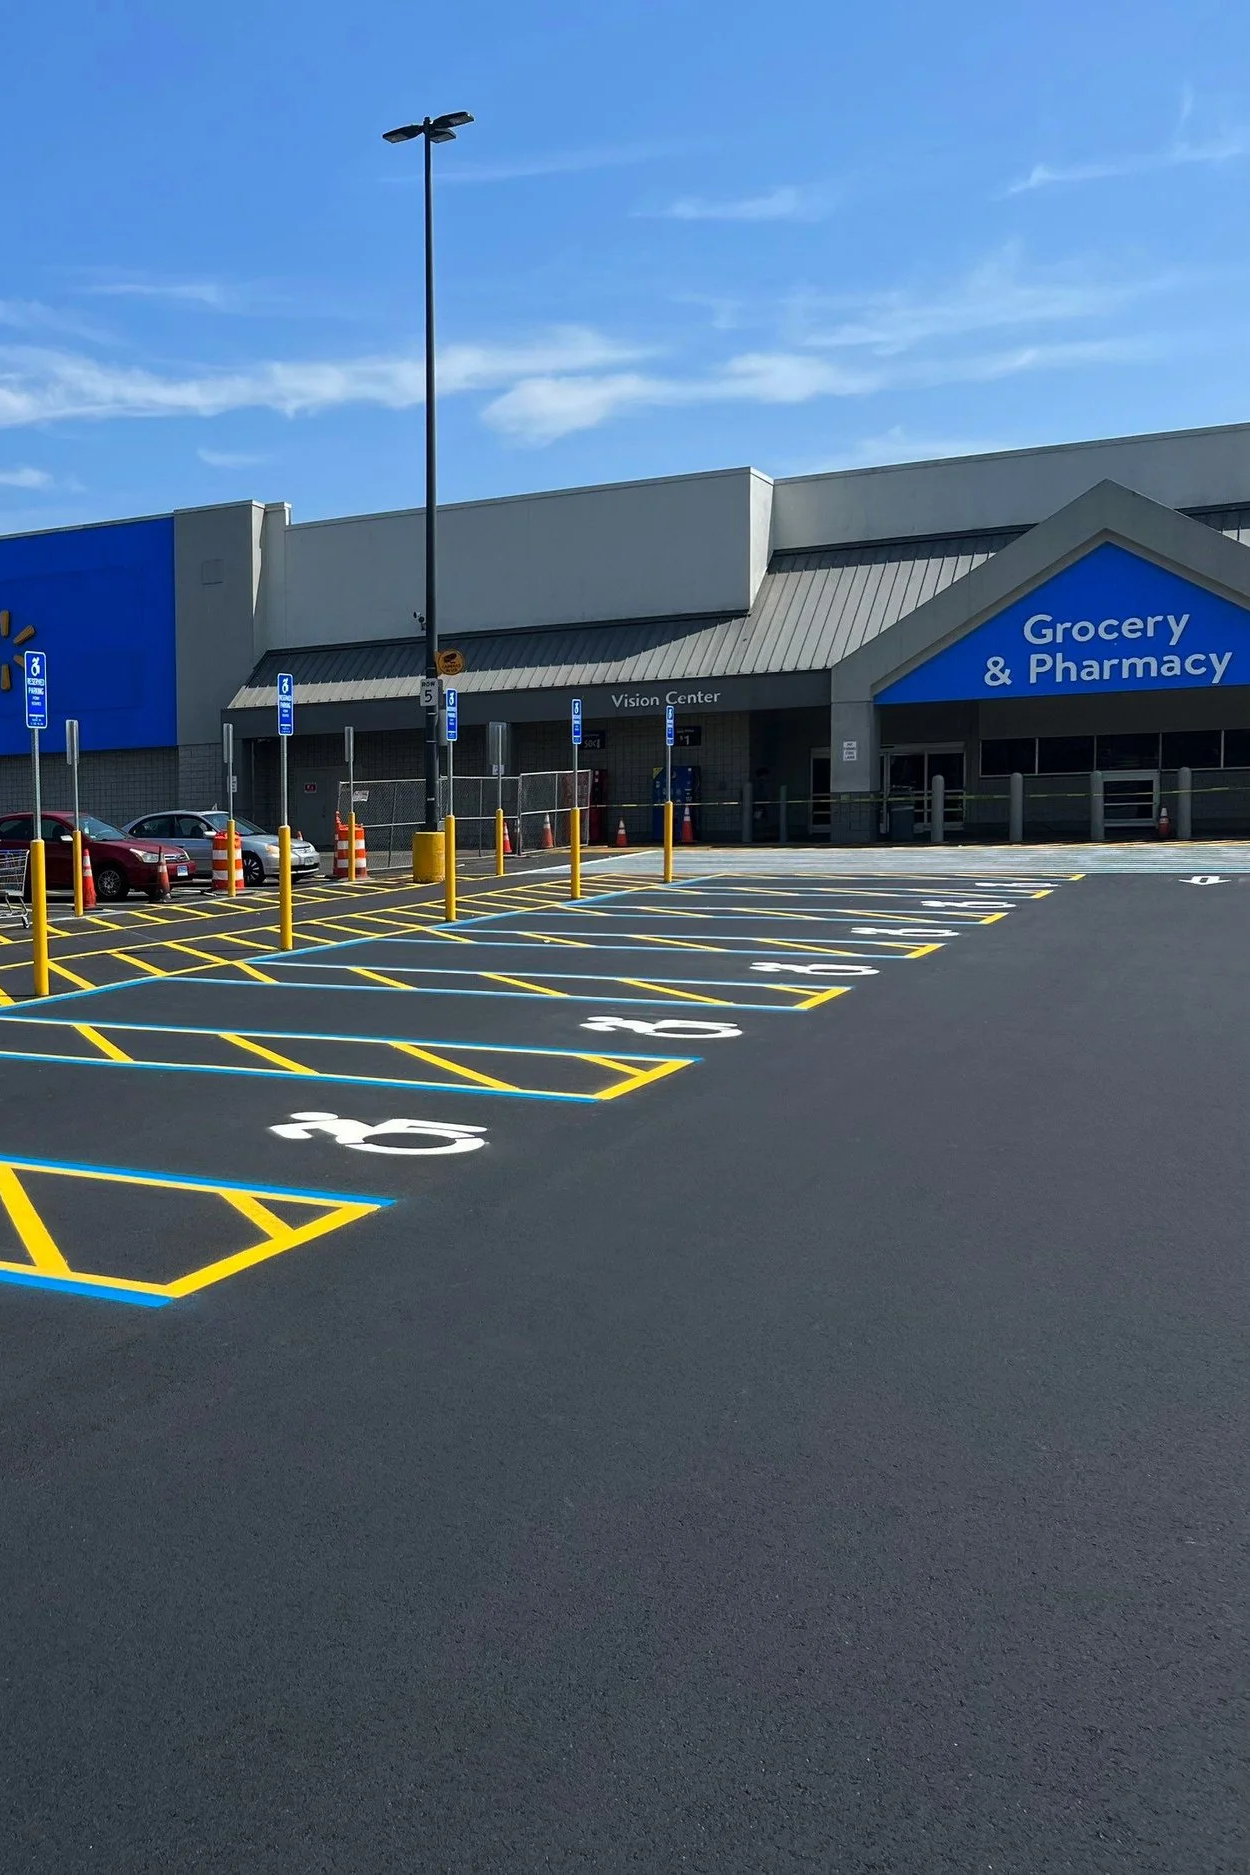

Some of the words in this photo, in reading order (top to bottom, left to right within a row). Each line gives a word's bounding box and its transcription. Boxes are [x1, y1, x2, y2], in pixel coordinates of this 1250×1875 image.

[1023, 613, 1190, 646] Grocery
[984, 656, 1012, 687] &
[1029, 651, 1233, 684] Pharmacy
[424, 690, 433, 703] 5
[611, 693, 660, 708] Vision
[665, 690, 721, 705] Center
